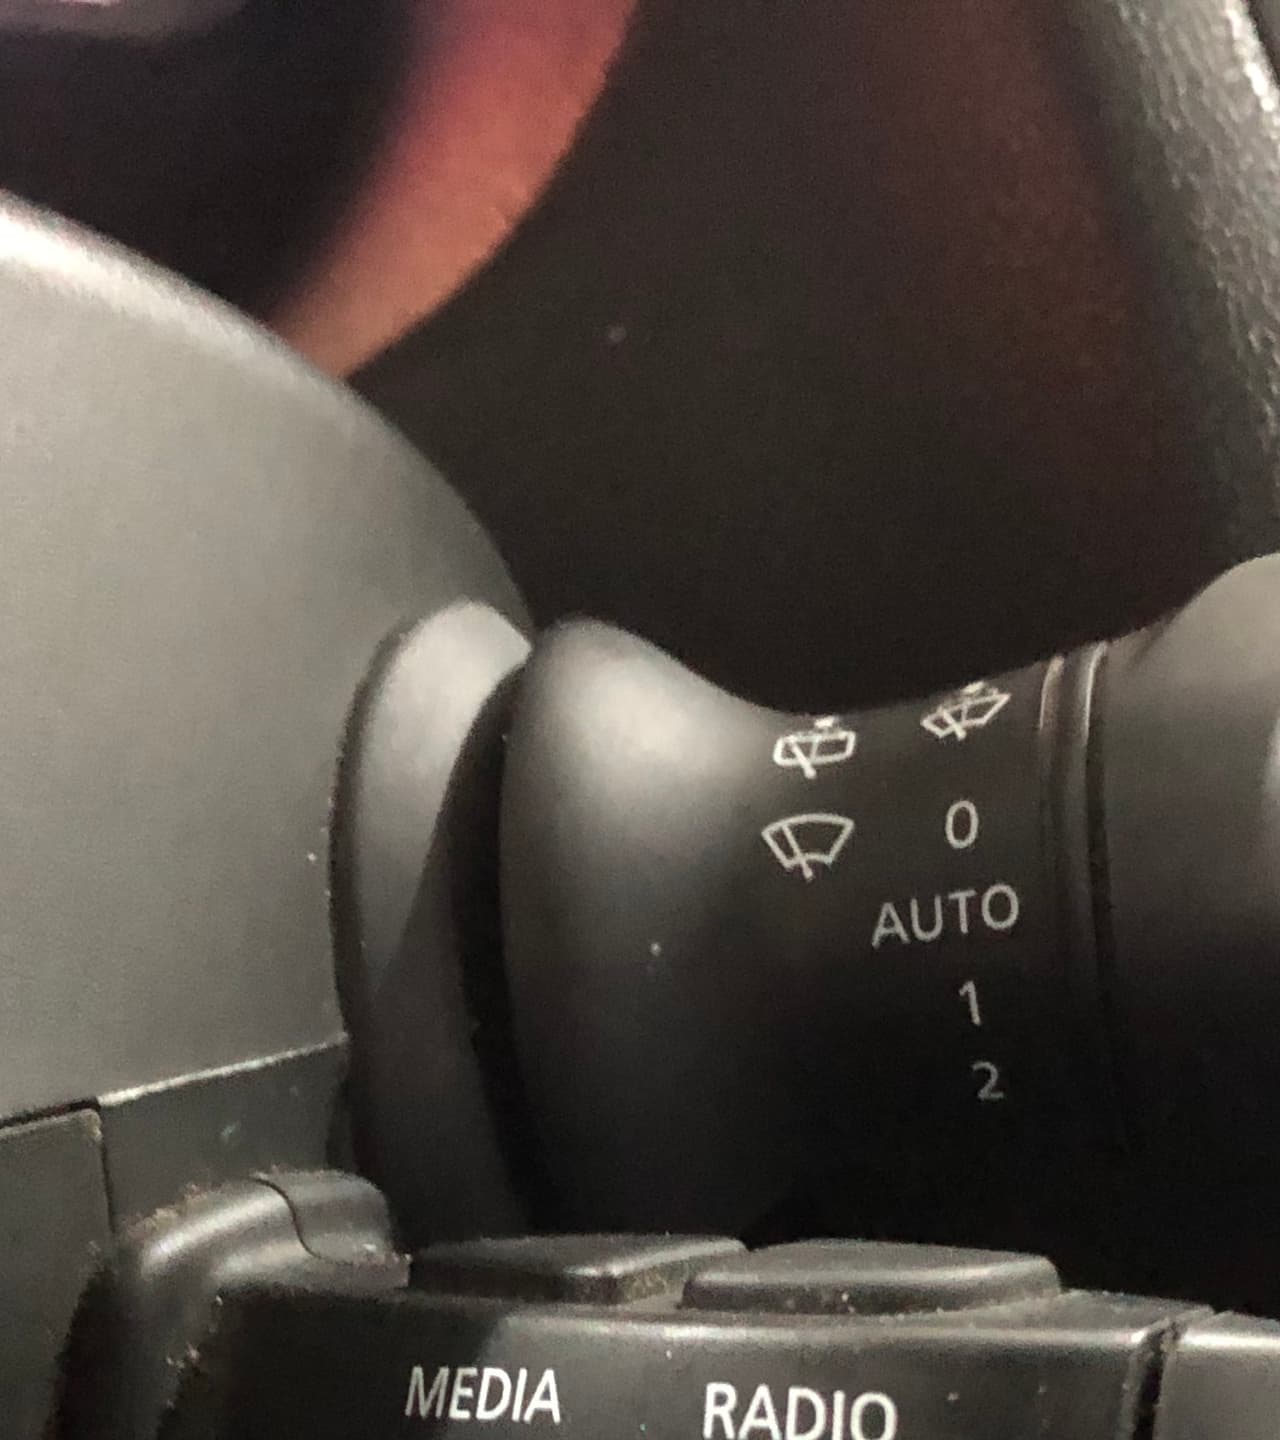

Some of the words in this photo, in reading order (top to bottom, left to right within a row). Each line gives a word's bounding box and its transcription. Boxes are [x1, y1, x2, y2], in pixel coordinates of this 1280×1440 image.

[945, 800, 980, 850] 0
[871, 883, 1019, 949] AUTO
[958, 980, 982, 1026] 1
[972, 1061, 1005, 1101] 2
[404, 1365, 562, 1425] MEDIA
